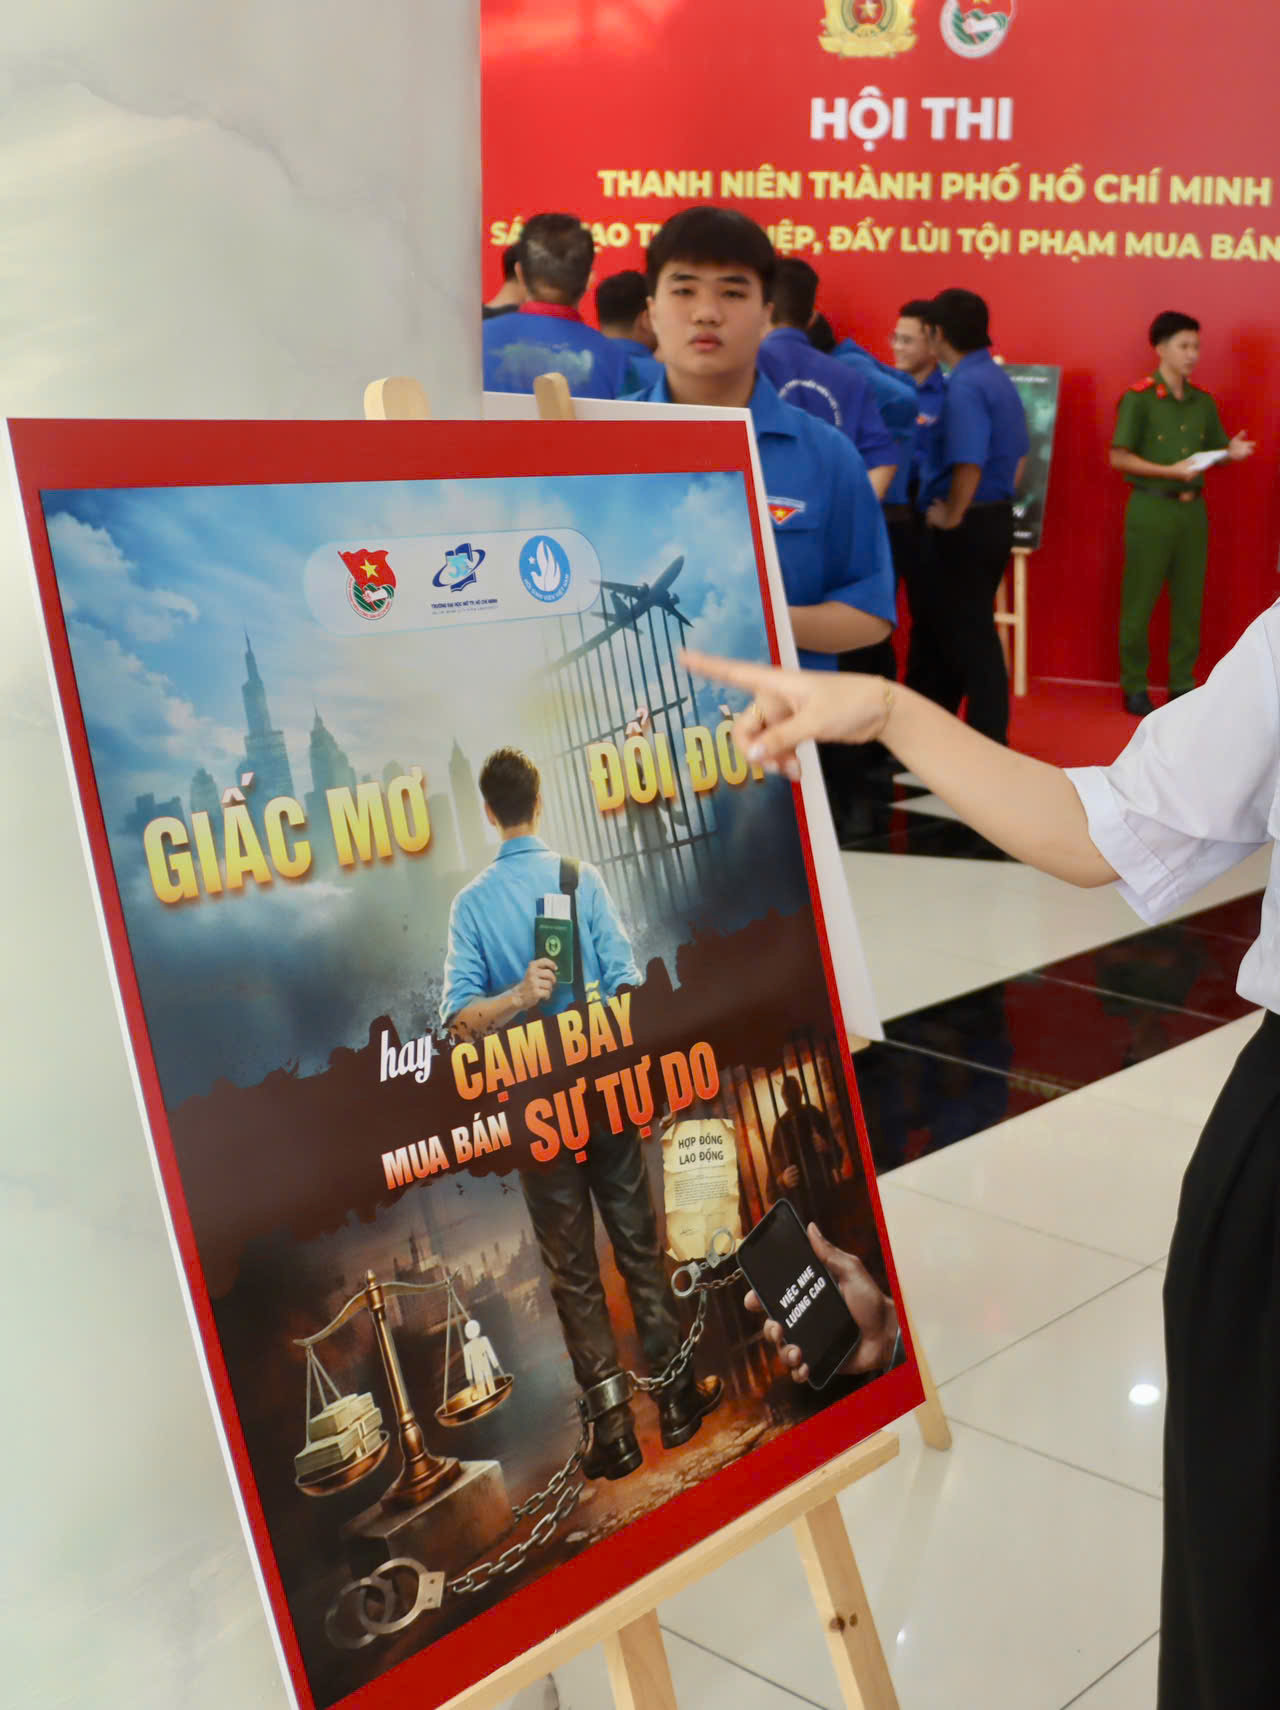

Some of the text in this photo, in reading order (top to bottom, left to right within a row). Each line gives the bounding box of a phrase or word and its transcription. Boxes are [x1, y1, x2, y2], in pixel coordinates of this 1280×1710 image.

[810, 85, 1014, 152] HỘI THI
[597, 161, 1273, 207] THANH NIÊN THÀNH PHỐ HỒ CHÍ MINH
[580, 221, 631, 252] ẠO
[828, 216, 894, 253] ĐẨY
[901, 220, 951, 253] LÙI
[957, 221, 1011, 261] TỘI
[1018, 229, 1117, 264] PHẠM
[1125, 231, 1203, 260] MUA
[143, 771, 312, 904] GIẤC
[325, 765, 431, 867] MƠ
[586, 704, 676, 812] ĐỔI
[379, 979, 634, 1103] hay CẠM BẪY
[381, 1041, 720, 1190] MUA BÁN SỰ TỰ DO
[678, 1136, 696, 1150] HỢP
[679, 1152, 696, 1166] LAO
[779, 1265, 815, 1309] VIỆC NHẸ
[785, 1276, 826, 1328] LƯƠNG CAO
